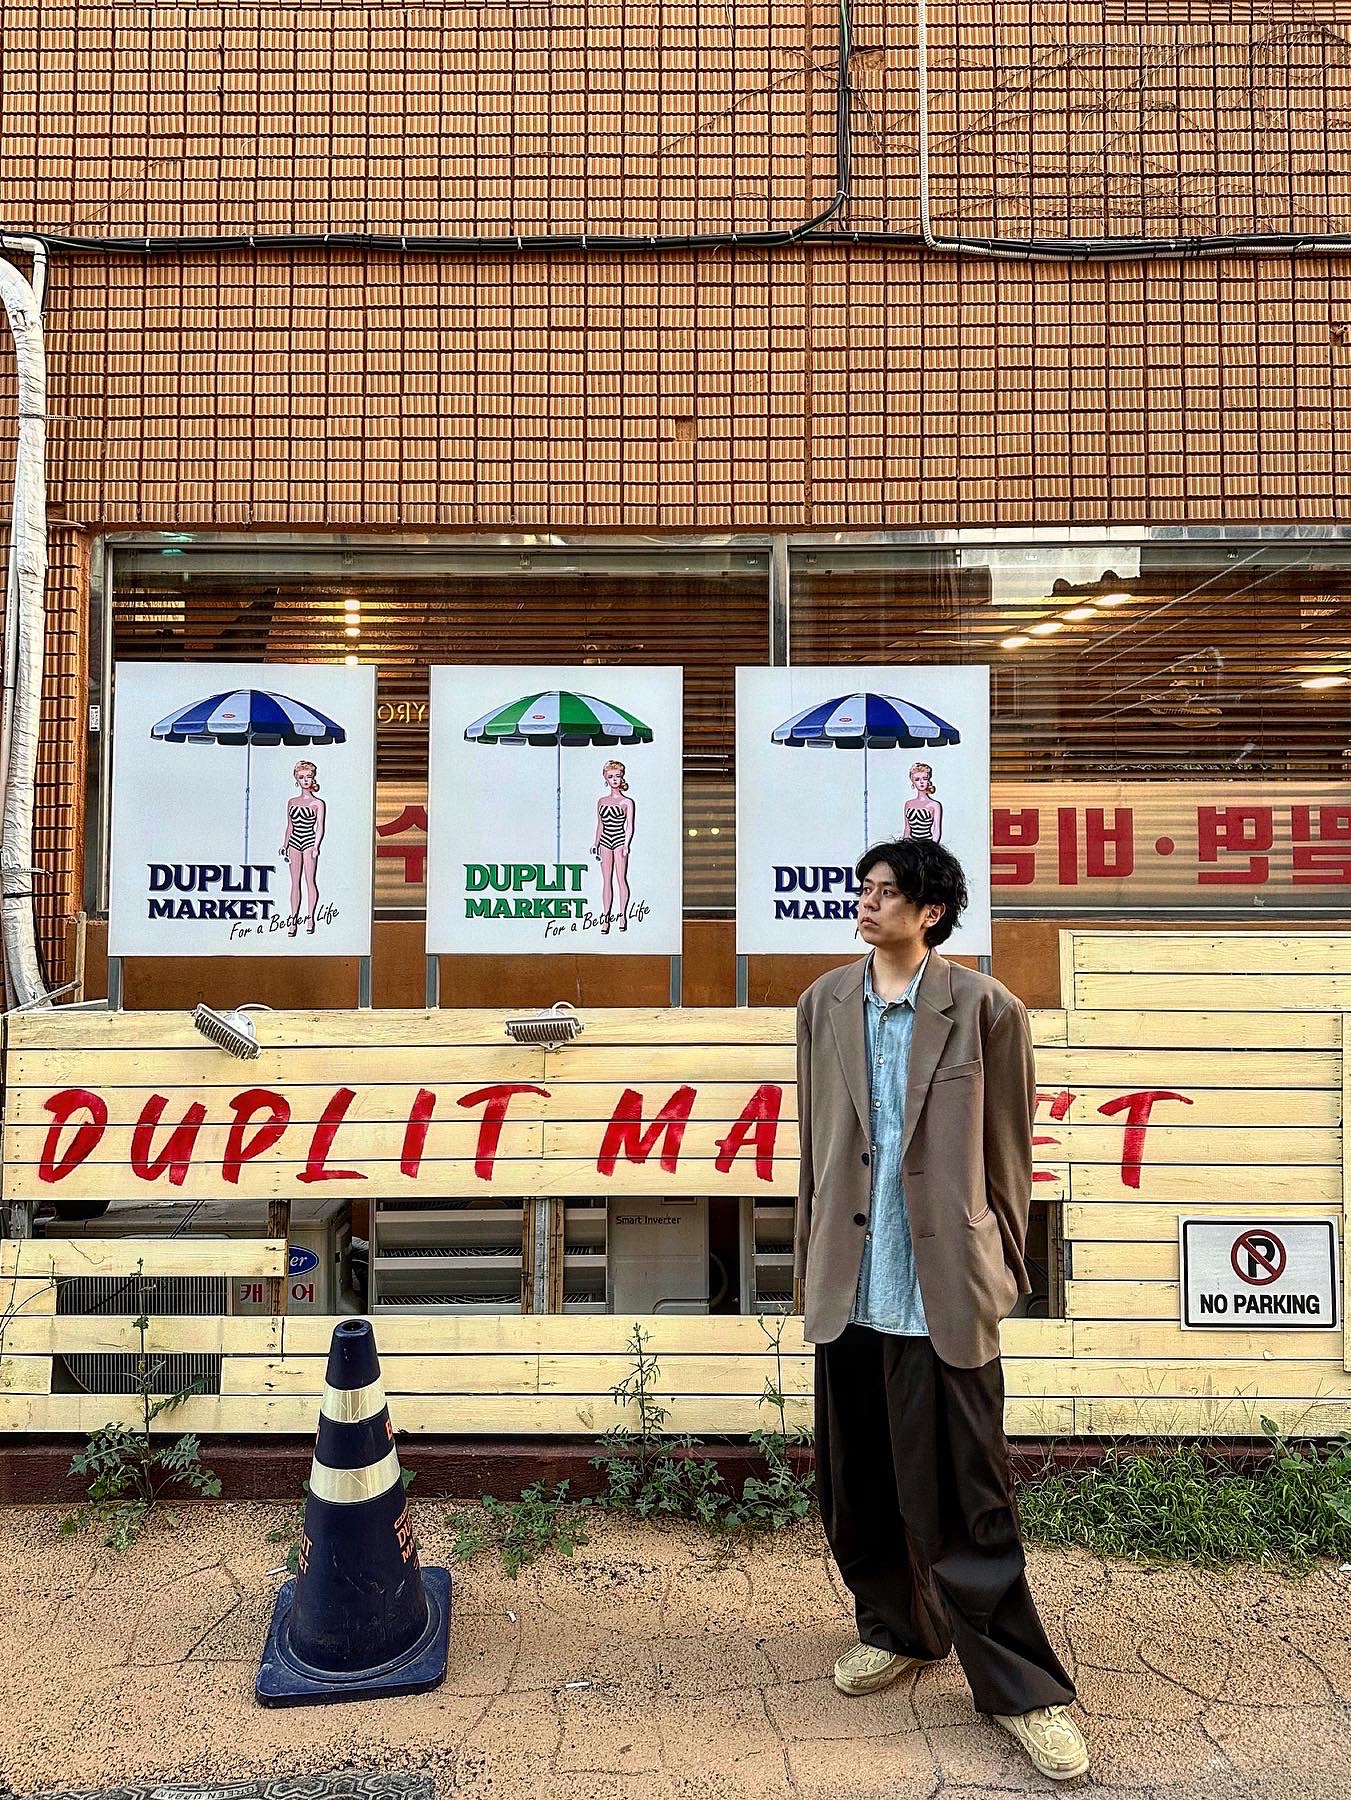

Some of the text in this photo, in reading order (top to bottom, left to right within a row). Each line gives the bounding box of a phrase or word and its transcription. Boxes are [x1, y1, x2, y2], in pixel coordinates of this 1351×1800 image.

[147, 863, 276, 893] DUPLIT
[463, 863, 588, 892] DUPLIT
[771, 866, 863, 893] DUPL
[147, 898, 275, 920] MARKET
[464, 898, 588, 919] MARKET
[544, 900, 651, 938] For a Better Life
[773, 900, 859, 920] MARK
[229, 902, 340, 940] For a Better Life
[38, 1084, 1194, 1189] DUPLIT MAET
[616, 1216, 681, 1225] Smart Inverter
[240, 1283, 315, 1303] 캐어
[1200, 1294, 1320, 1315] NO PARKING
